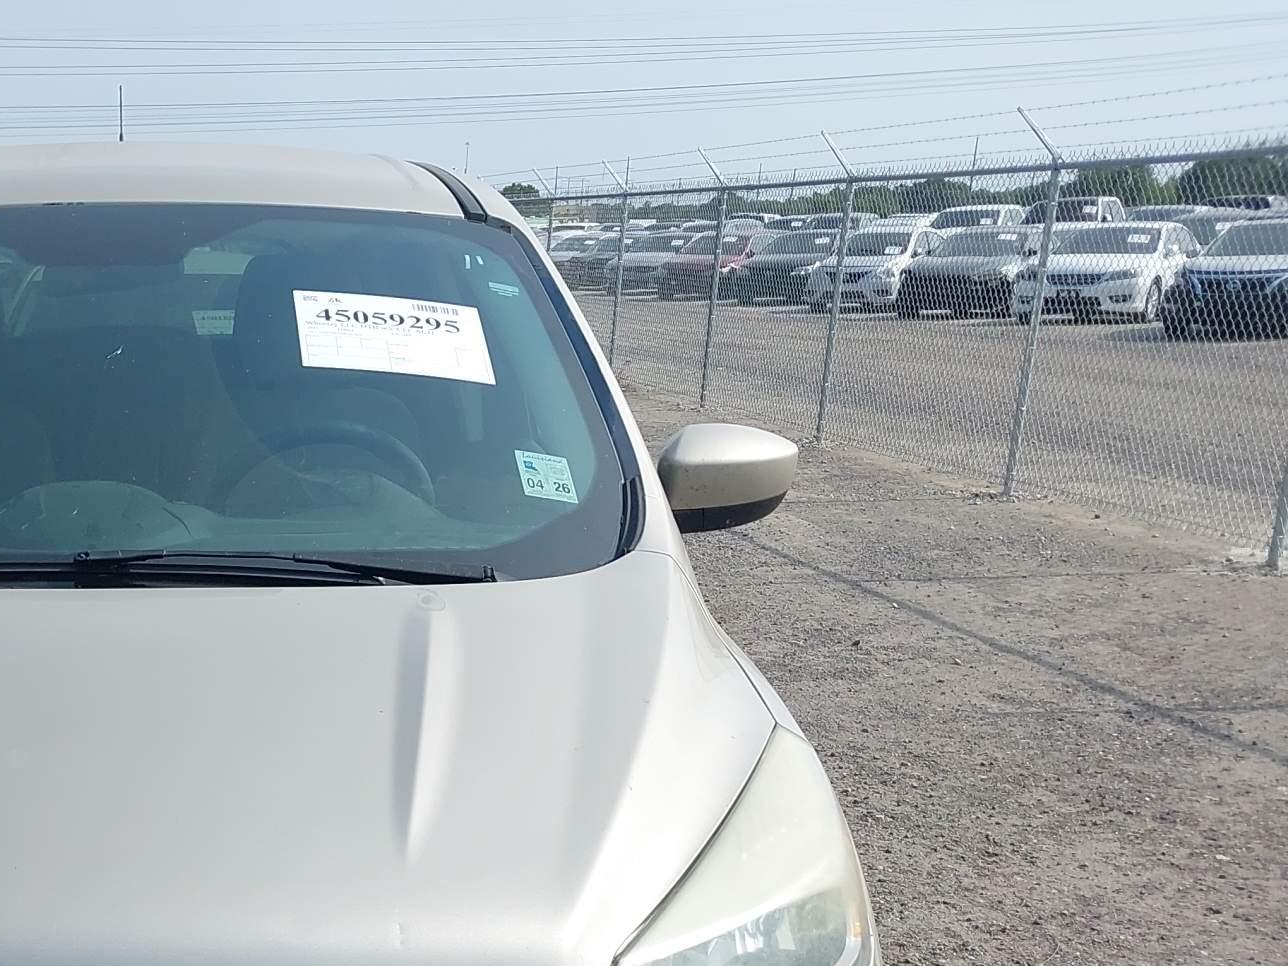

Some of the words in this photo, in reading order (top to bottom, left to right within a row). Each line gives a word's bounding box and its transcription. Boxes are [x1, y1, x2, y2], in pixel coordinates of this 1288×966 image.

[316, 308, 460, 334] 45059295
[527, 478, 544, 490] 04
[553, 482, 571, 494] 26
